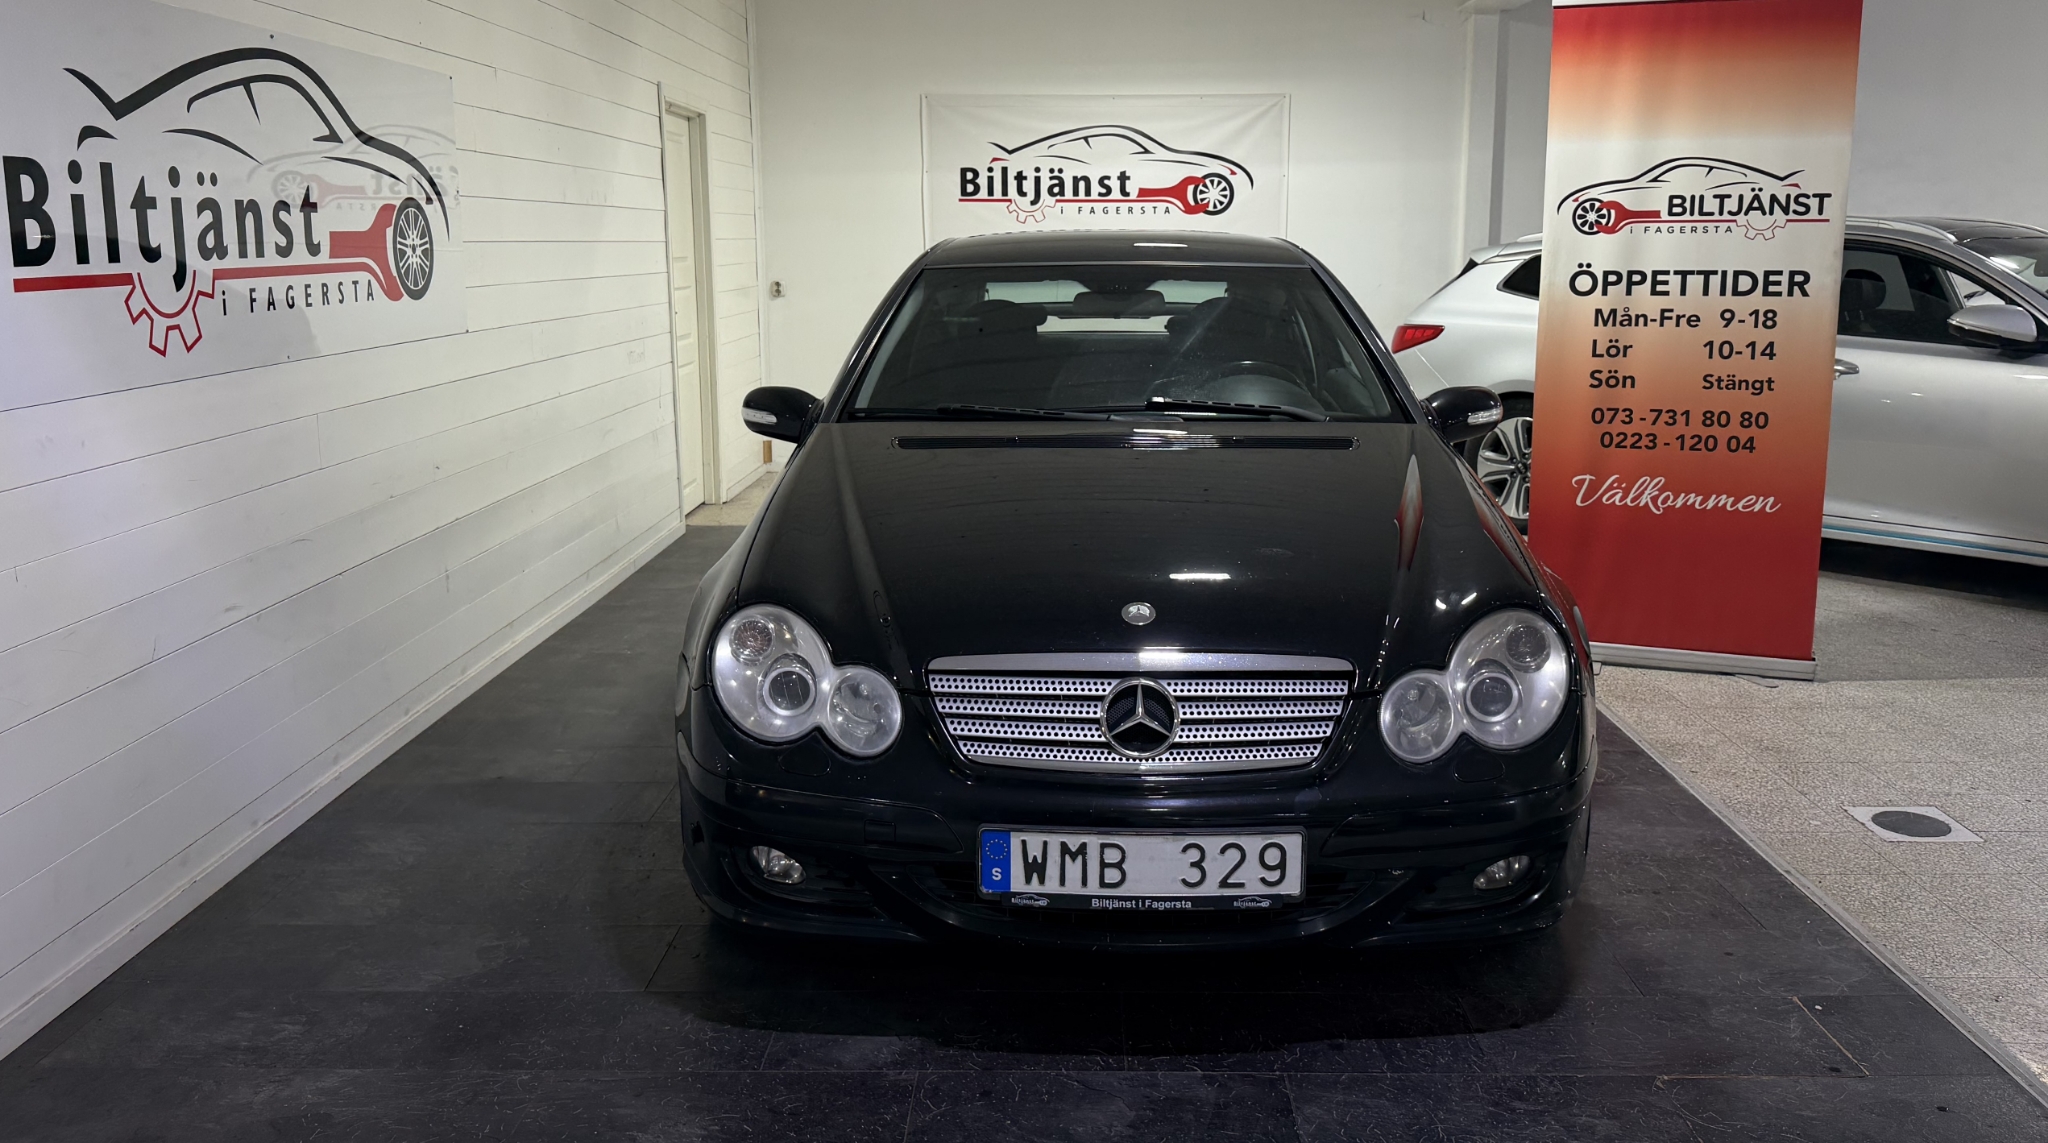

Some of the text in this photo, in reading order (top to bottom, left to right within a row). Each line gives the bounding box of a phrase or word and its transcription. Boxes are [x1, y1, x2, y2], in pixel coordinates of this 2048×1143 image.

[959, 167, 1131, 205] Biltjänst
[1078, 206, 1171, 215] FAGERSTA
[1667, 187, 1832, 217] BILTJÄNST
[3, 156, 321, 292] Biltjänst
[1644, 226, 1733, 234] FAGERSTA
[1568, 262, 1811, 298] ÖPPETTIDER
[221, 279, 374, 316] i FAGERSTA
[1593, 307, 1778, 329] Mån-Fre 9-18
[1591, 339, 1777, 361] Lör 10-14
[1589, 370, 1775, 395] Sön Stängt
[1701, 411, 1731, 429] 80
[1740, 412, 1769, 429] 80
[1726, 435, 1756, 453] 04
[1572, 474, 1781, 515] Välkommen
[991, 867, 1002, 881] S
[1021, 839, 1287, 889] WMB 329
[1092, 898, 1137, 909] Biltjänst
[1145, 899, 1192, 910] Fagersta
